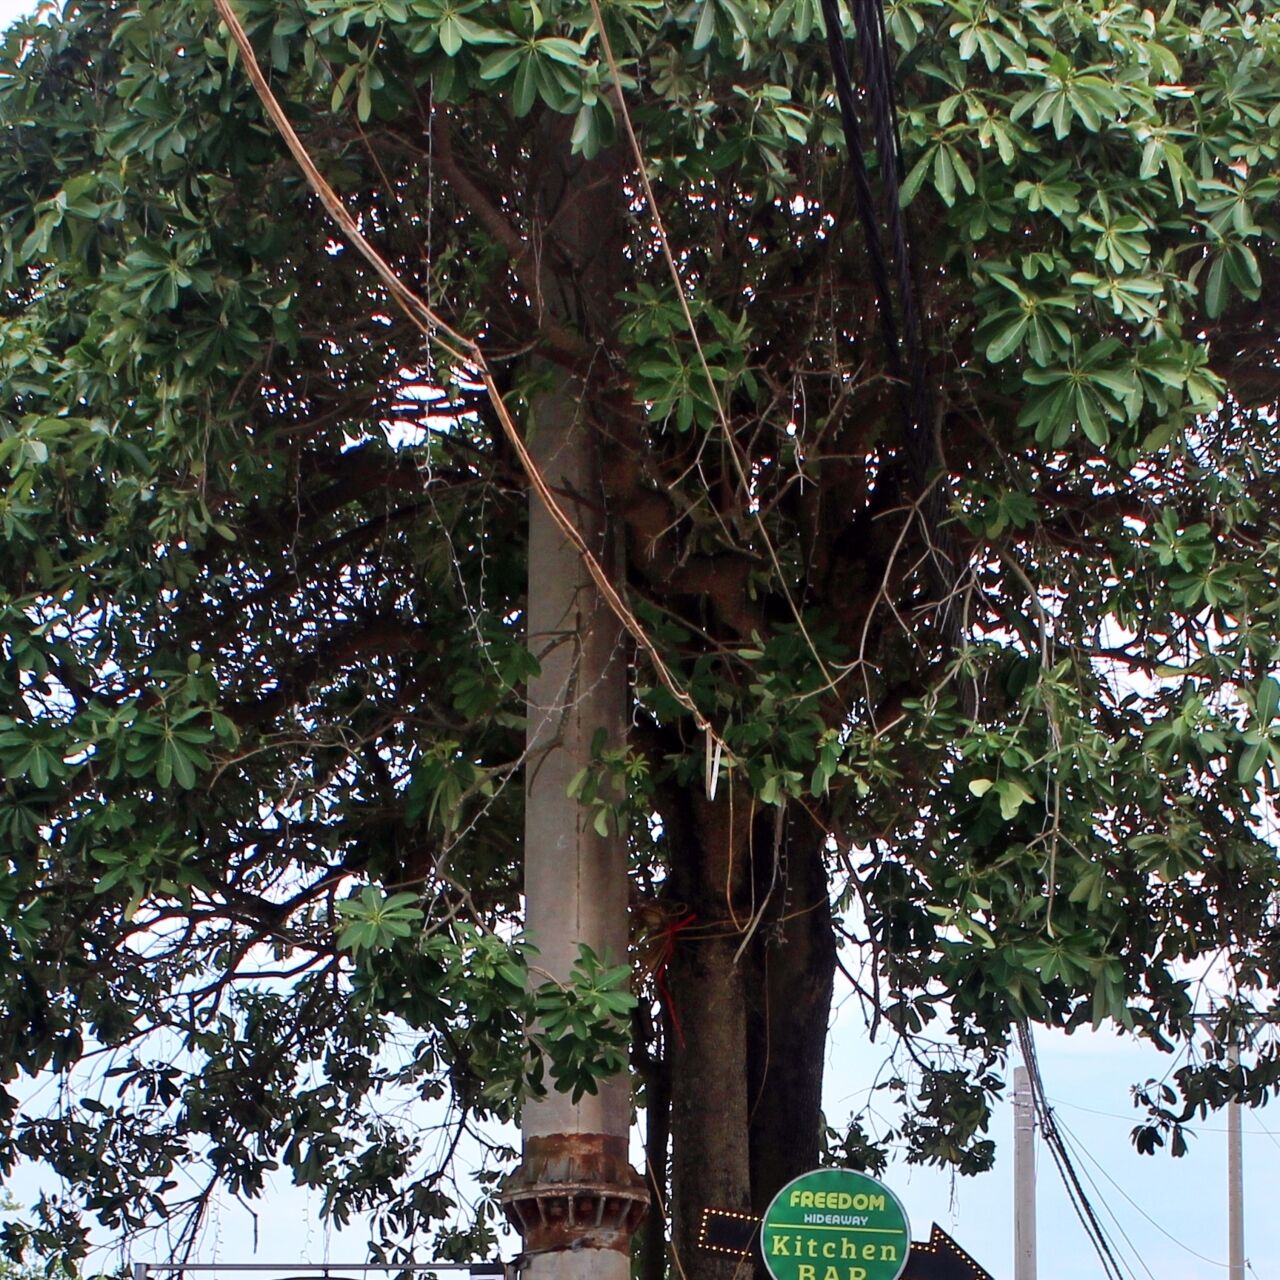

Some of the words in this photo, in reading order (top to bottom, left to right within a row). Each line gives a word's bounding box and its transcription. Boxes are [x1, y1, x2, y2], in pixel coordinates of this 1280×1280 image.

[789, 1190, 886, 1211] FREEDOM
[803, 1213, 869, 1226] HIDEAWAY
[771, 1235, 898, 1261] Kitchen
